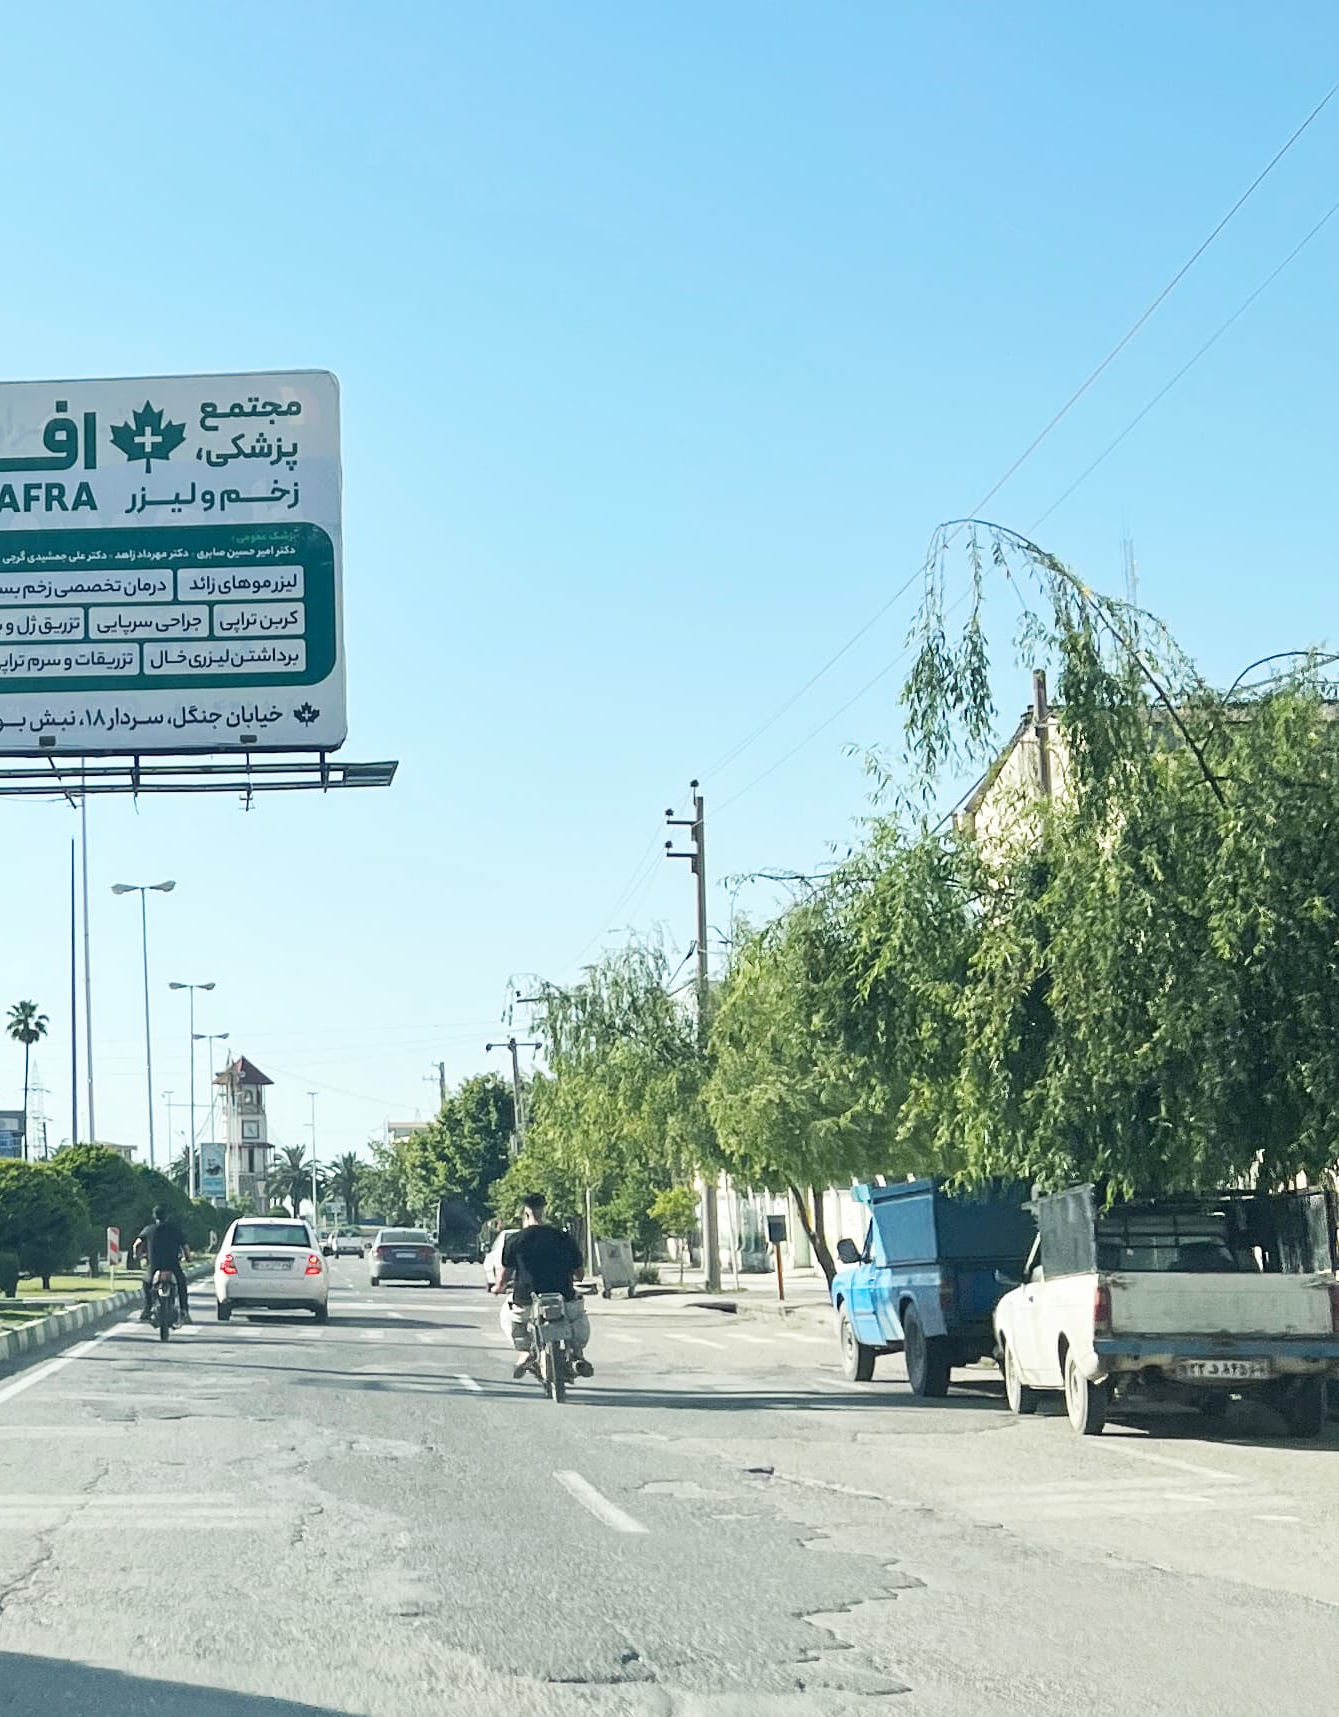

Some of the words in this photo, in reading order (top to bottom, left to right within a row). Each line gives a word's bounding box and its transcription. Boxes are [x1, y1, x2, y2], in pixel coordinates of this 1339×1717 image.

[199, 396, 302, 431] مجتمع
[195, 432, 298, 471] پزشکی،
[124, 481, 197, 514] لیزر
[201, 489, 215, 512] و
[219, 479, 299, 512] زخم
[27, 551, 67, 564] جمشیدی
[69, 550, 86, 563] علی
[86, 551, 107, 562] دکتر
[114, 549, 137, 562] زاهد
[137, 549, 167, 561] مهرداد
[168, 548, 189, 560] دکتر
[196, 547, 228, 560] صابری
[228, 548, 255, 559] حسین
[256, 546, 274, 558] امیر
[275, 545, 296, 557] دکتر
[22, 579, 52, 599] زخم
[54, 578, 122, 598] تخصصی
[123, 577, 167, 596] درمان
[189, 575, 217, 595] زائد
[218, 575, 271, 595] موهای
[271, 573, 298, 593] لیزر
[5, 624, 14, 636] و
[16, 615, 37, 636] ژل
[38, 617, 80, 635] تزریق
[97, 614, 152, 635] سرپایی
[155, 612, 202, 632] جراحی
[220, 611, 257, 633] تراپی
[259, 610, 298, 630] کربن
[27, 656, 62, 672] سرم
[63, 657, 73, 671] و
[74, 651, 134, 670] تزریقات
[150, 648, 188, 669] خال
[188, 648, 230, 668] لیزری
[231, 647, 299, 667] برداشتن
[30, 708, 76, 732] نبش
[106, 707, 163, 731] سردار
[167, 706, 222, 730] جنگل،
[226, 704, 283, 728] خیابان
